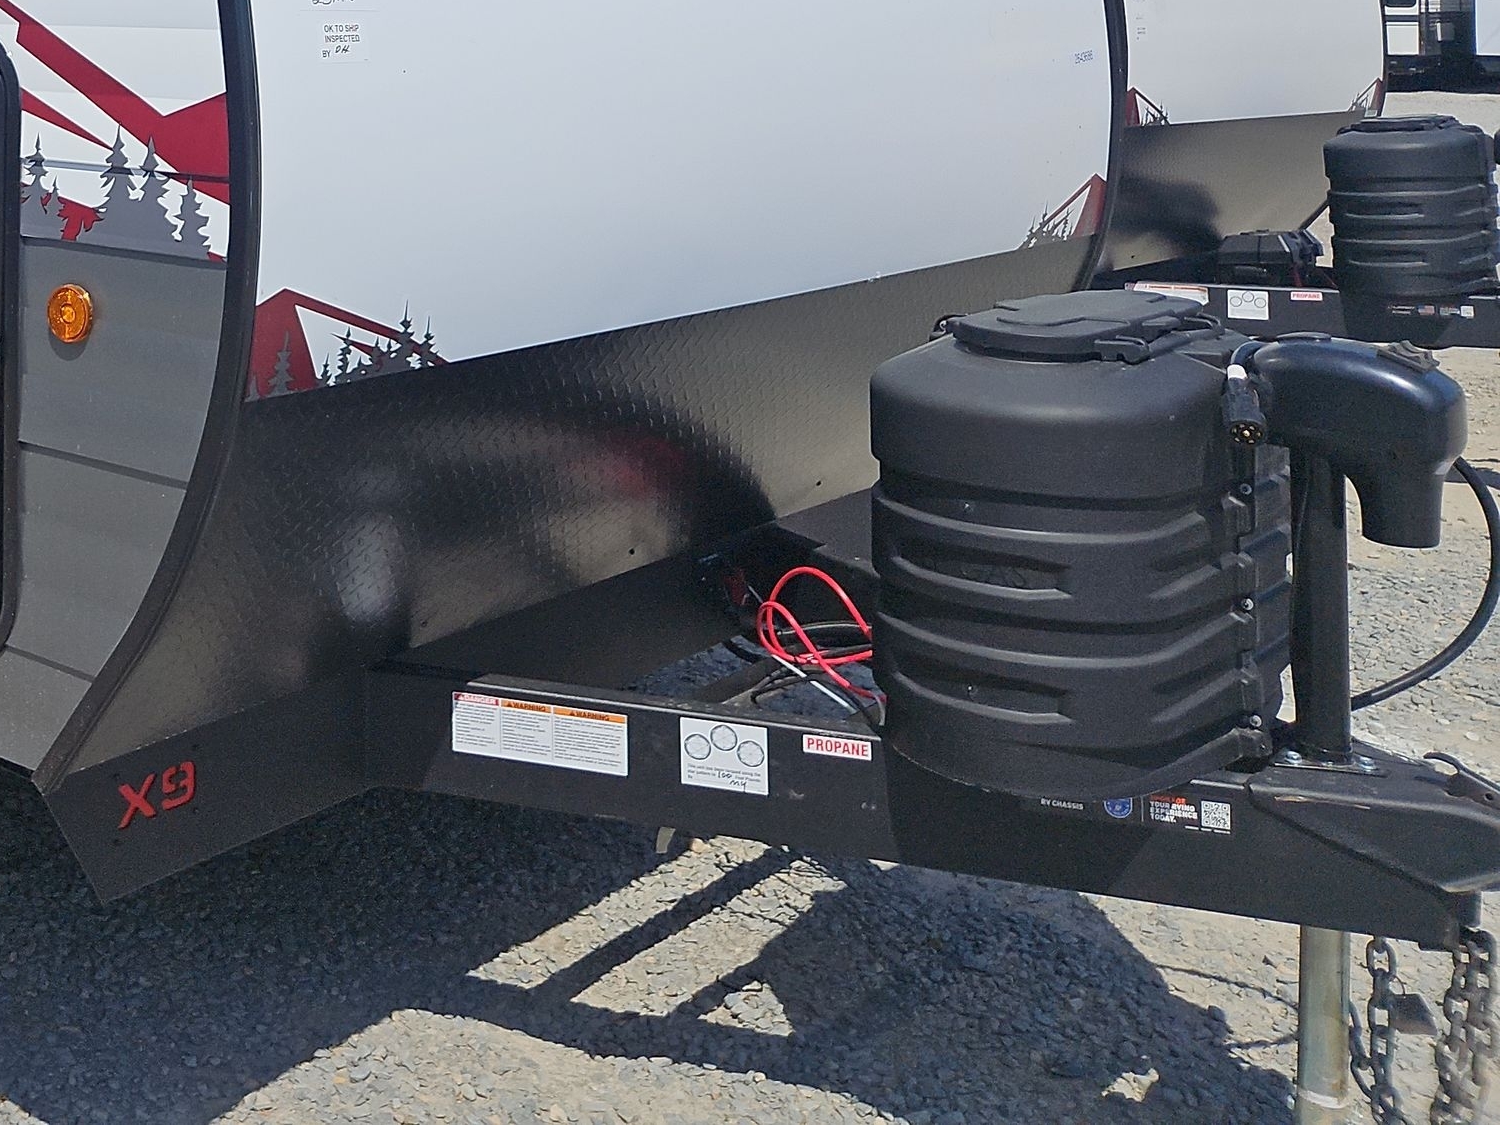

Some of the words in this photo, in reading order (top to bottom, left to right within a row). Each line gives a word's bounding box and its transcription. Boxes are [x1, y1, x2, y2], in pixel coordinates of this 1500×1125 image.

[323, 24, 334, 33] OK
[334, 24, 344, 33] TO
[345, 24, 359, 33] SHIP
[324, 34, 360, 43] INSPECTED
[322, 49, 331, 58] BY
[512, 702, 546, 713] WARNING
[575, 711, 610, 721] WARNING
[807, 738, 869, 757] PROPANE
[118, 761, 195, 830] X9
[1040, 797, 1051, 806] RV
[1052, 800, 1084, 810] CHASSIS
[1150, 801, 1170, 810] YOUR
[1150, 806, 1198, 819] EXPERIENCE
[1150, 813, 1177, 823] TODAY.
